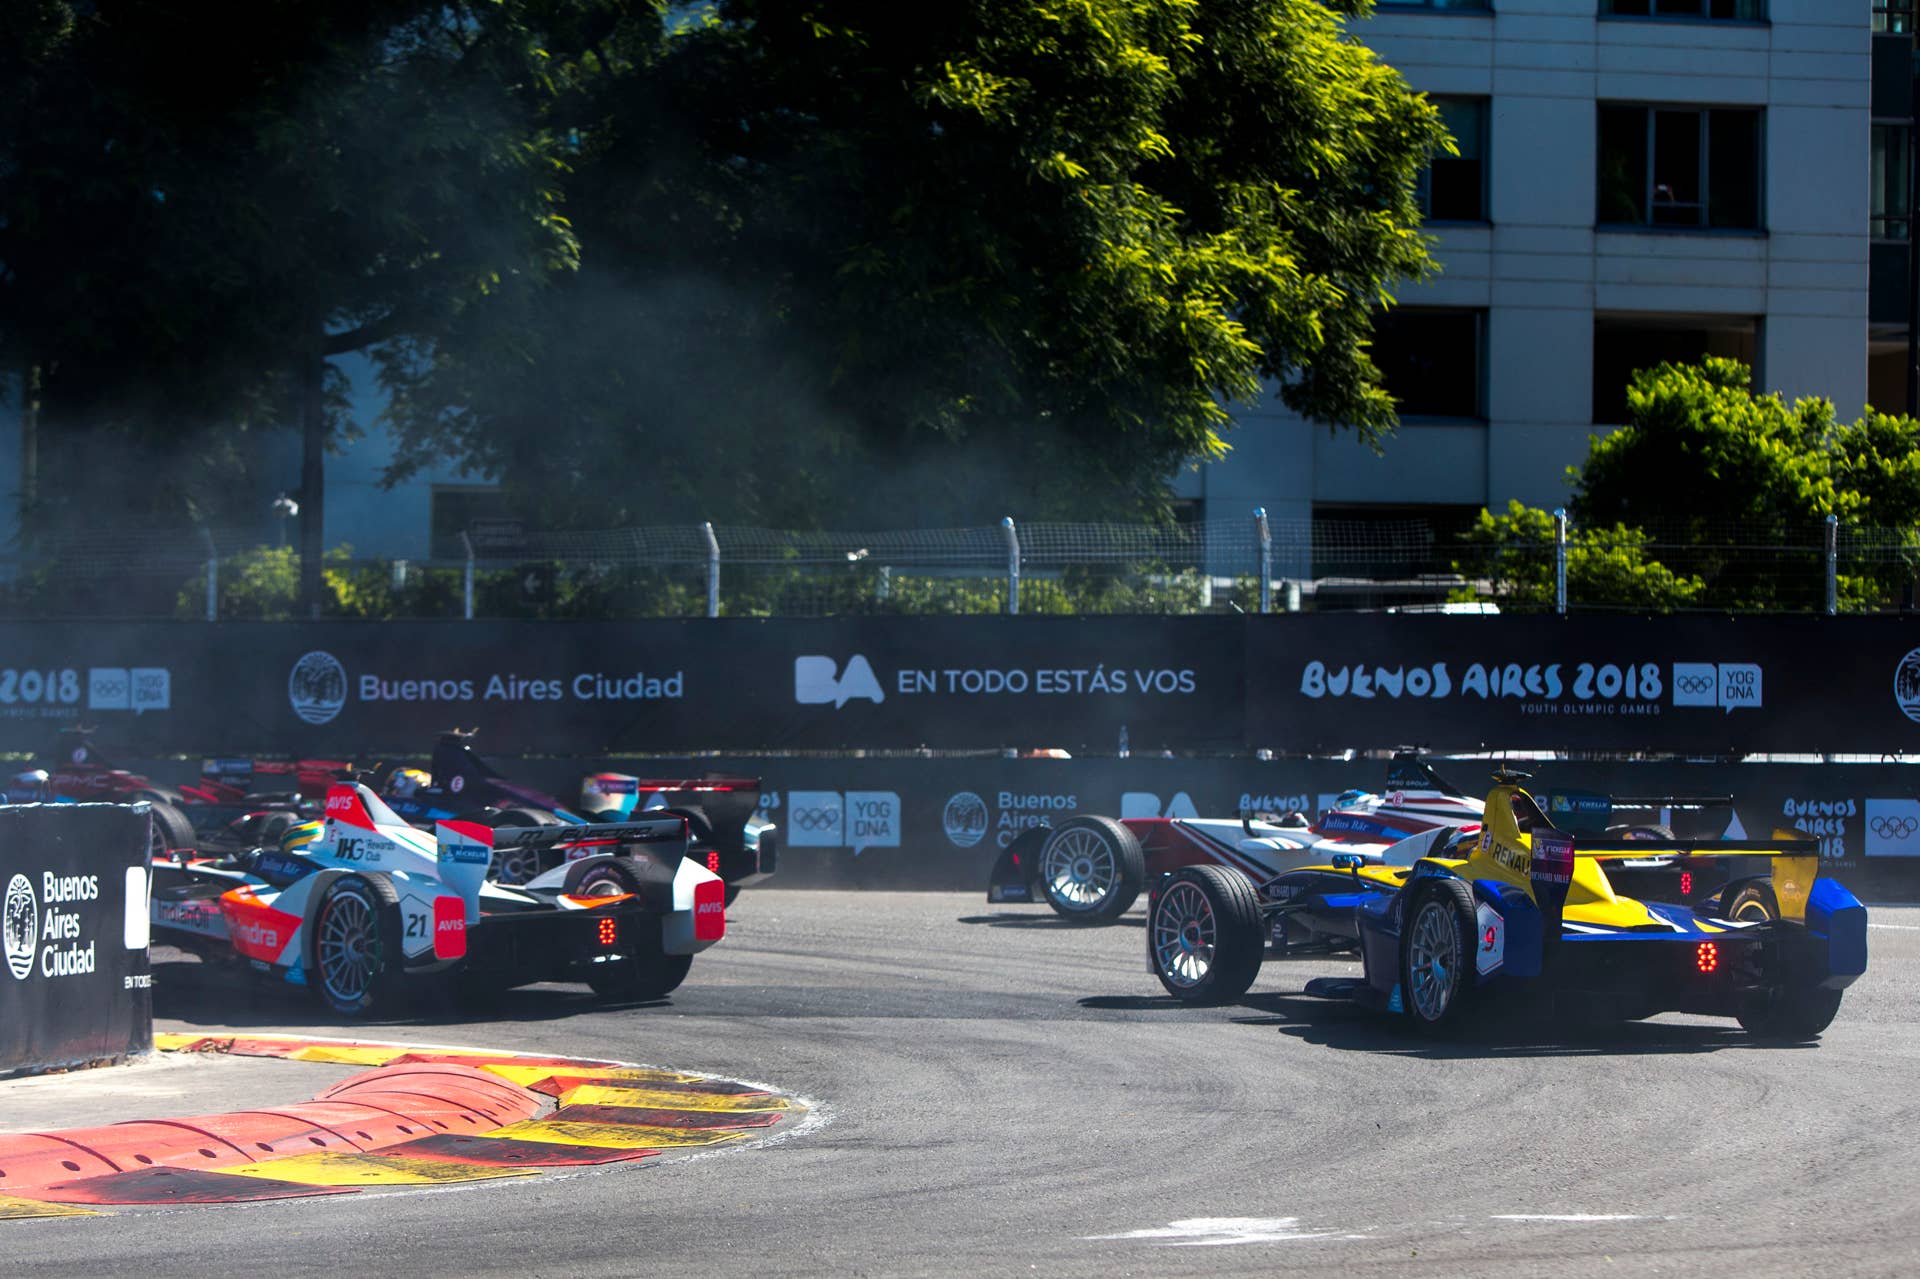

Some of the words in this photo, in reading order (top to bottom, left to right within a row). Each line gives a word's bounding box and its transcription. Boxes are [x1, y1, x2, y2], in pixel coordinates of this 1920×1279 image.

[0, 669, 80, 704] 2018
[359, 674, 474, 702] Buenos
[484, 673, 563, 701] Aires
[573, 671, 683, 700] Ciudad
[795, 655, 884, 708] BA
[897, 669, 937, 693] EN
[944, 669, 1029, 693] TODO
[1037, 664, 1128, 694] ESTÁS
[1134, 669, 1196, 694] VOS
[1300, 660, 1452, 699] BUENOS
[1461, 662, 1563, 699] AIRES
[1572, 662, 1663, 700] 2018
[1726, 670, 1755, 685] YOG
[1726, 685, 1755, 700] DNA
[1520, 703, 1558, 715] YOUTH
[1563, 703, 1615, 715] OLYMPIC
[1620, 703, 1661, 715] GAMES
[327, 796, 354, 811] AVIS
[998, 791, 1077, 809] Buenos
[1239, 793, 1310, 811] BUENOS
[1783, 798, 1857, 817] BUENOS
[856, 801, 891, 819] YOG
[855, 820, 890, 837] DNA
[997, 811, 1050, 829] Aires
[1795, 818, 1845, 837] AIRES
[336, 837, 364, 861] IHG
[1493, 844, 1531, 875] RENAU
[43, 871, 98, 903] Buenos
[698, 902, 722, 914] AVIS
[42, 907, 80, 941] Aires
[406, 913, 426, 937] 21
[438, 919, 464, 931] AVIS
[41, 940, 95, 978] Ciudad
